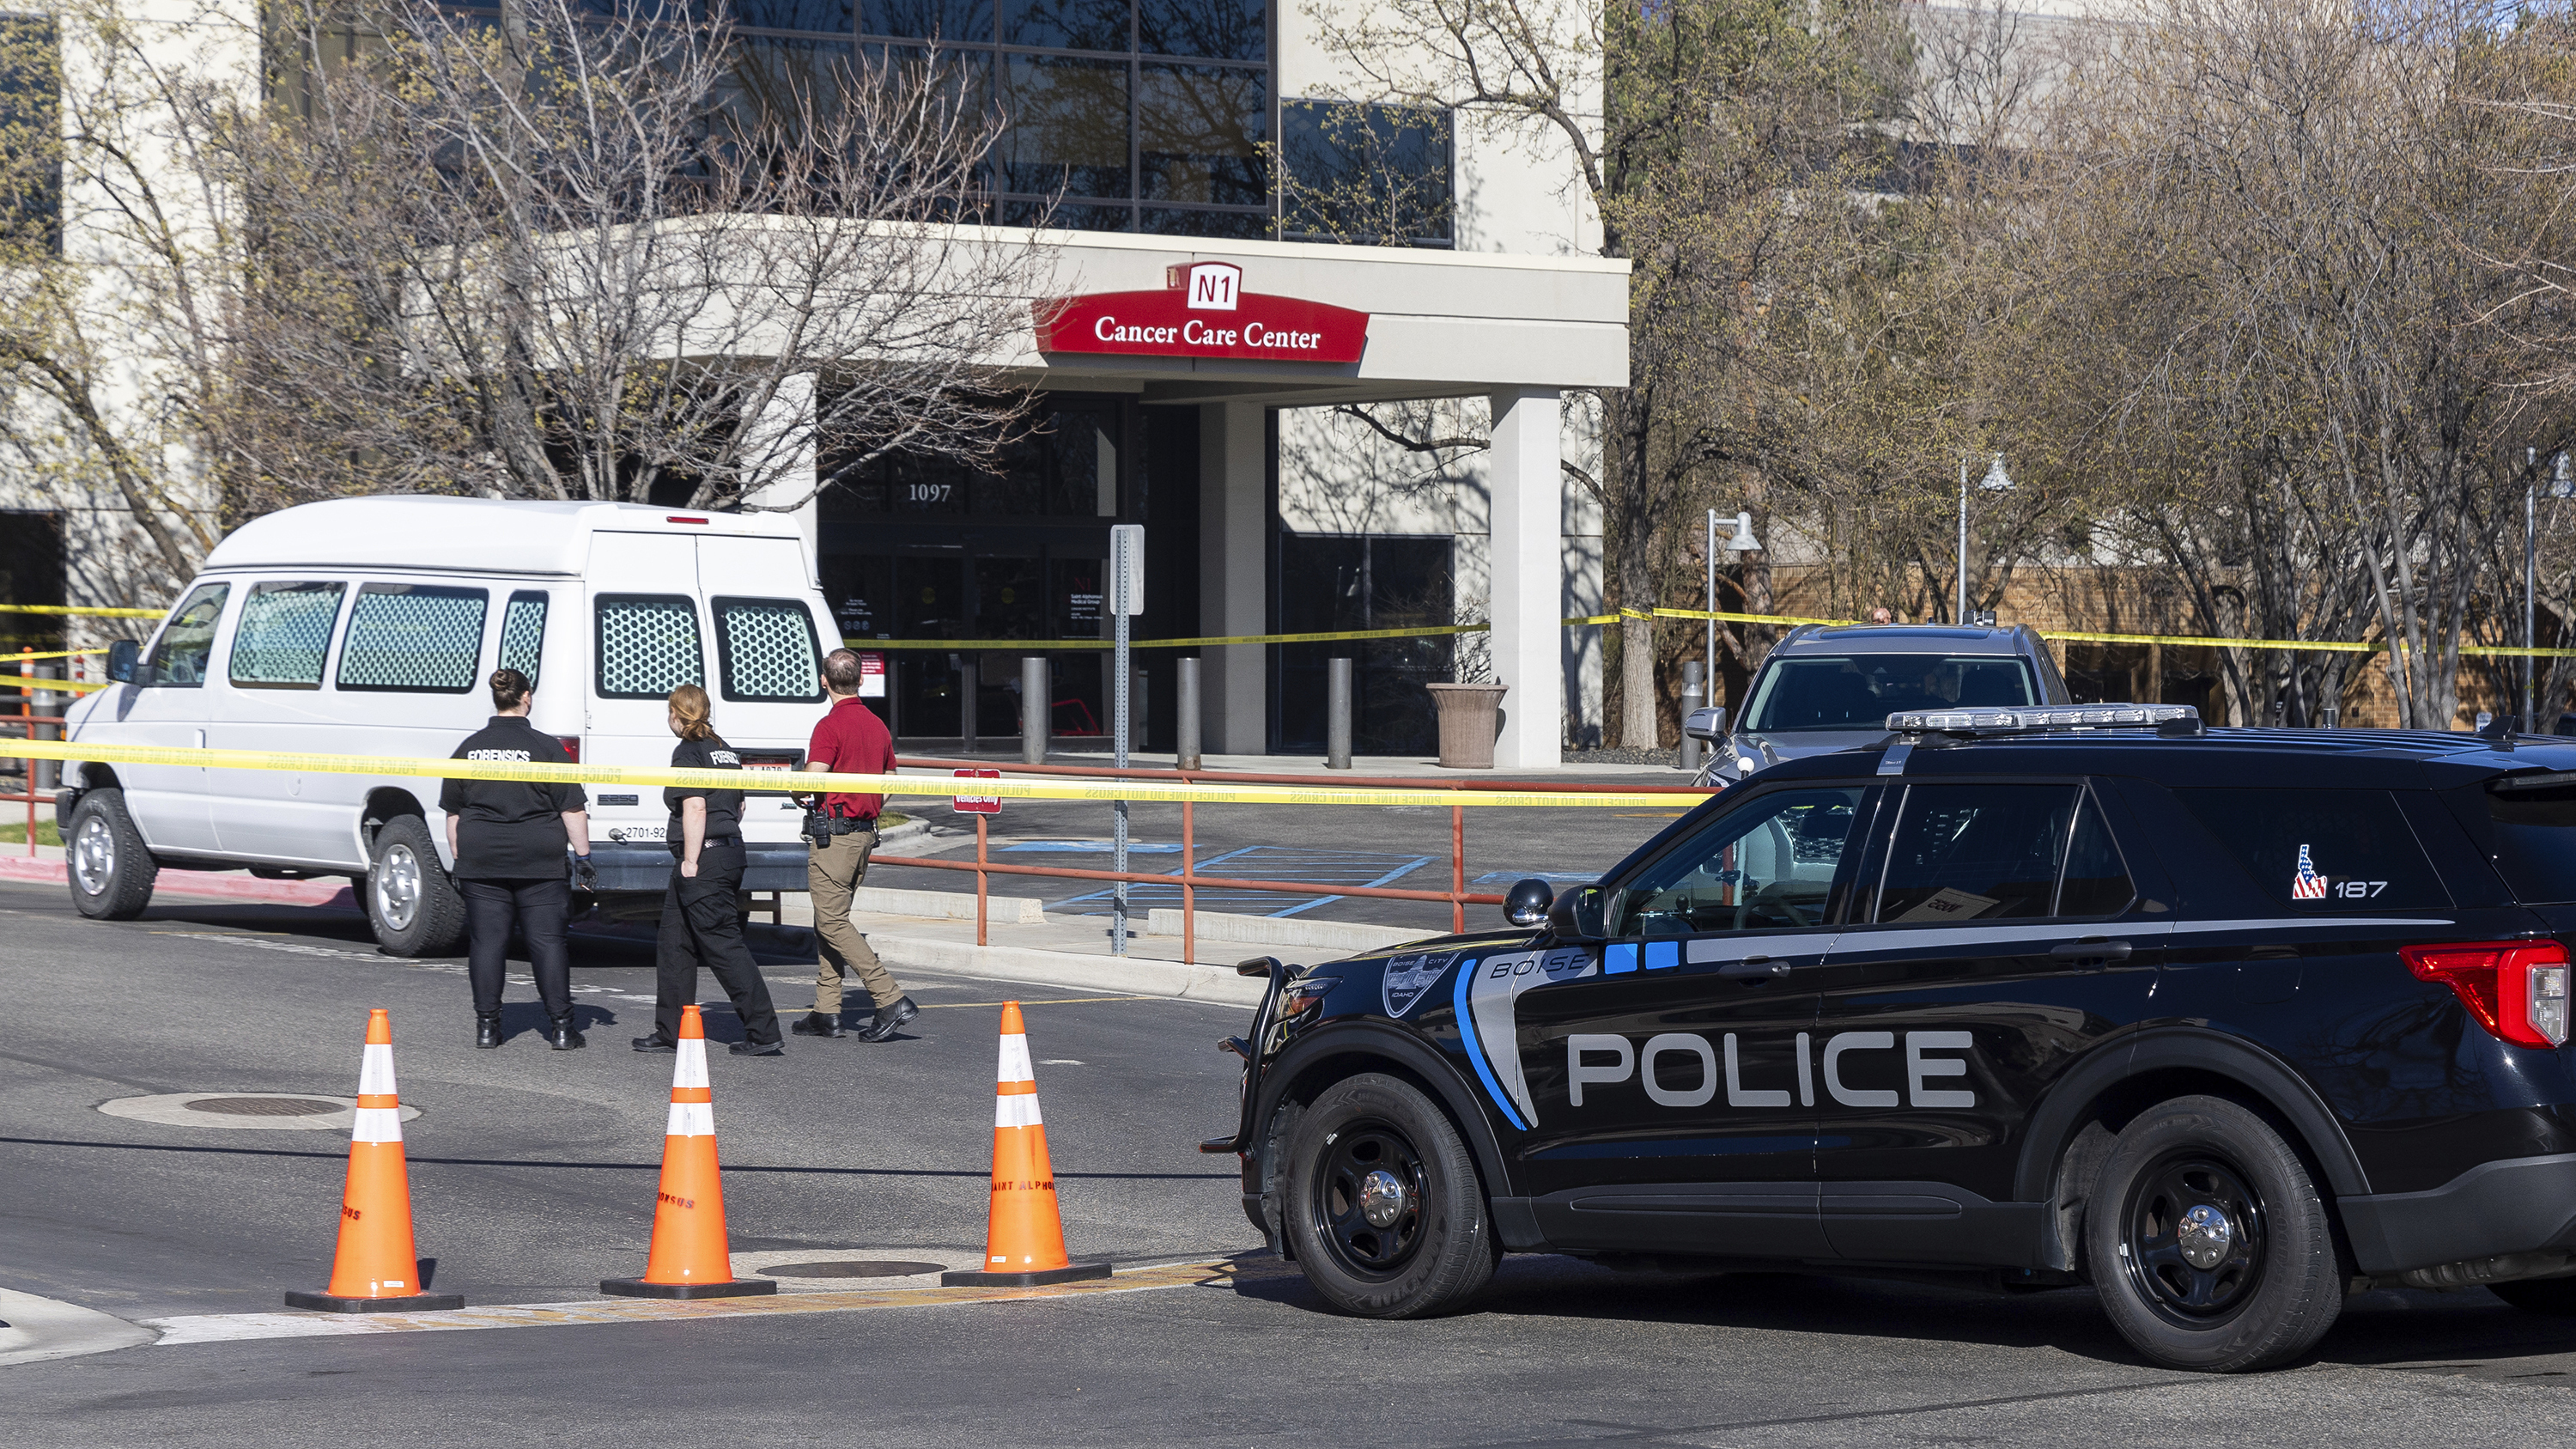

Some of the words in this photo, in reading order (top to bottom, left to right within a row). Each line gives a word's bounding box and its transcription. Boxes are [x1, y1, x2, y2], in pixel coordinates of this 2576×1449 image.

[1197, 274, 1230, 302] N1
[1094, 316, 1178, 344] Cancer
[1182, 319, 1236, 346] Care
[1243, 322, 1321, 349] Center
[909, 484, 951, 502] 1097
[468, 749, 531, 763] FORENSICS
[2335, 881, 2388, 898] 187
[1490, 953, 1589, 979] BOISE
[1568, 1032, 1975, 1107] POLICE
[1370, 1228, 1444, 1310] GOODYEAR
